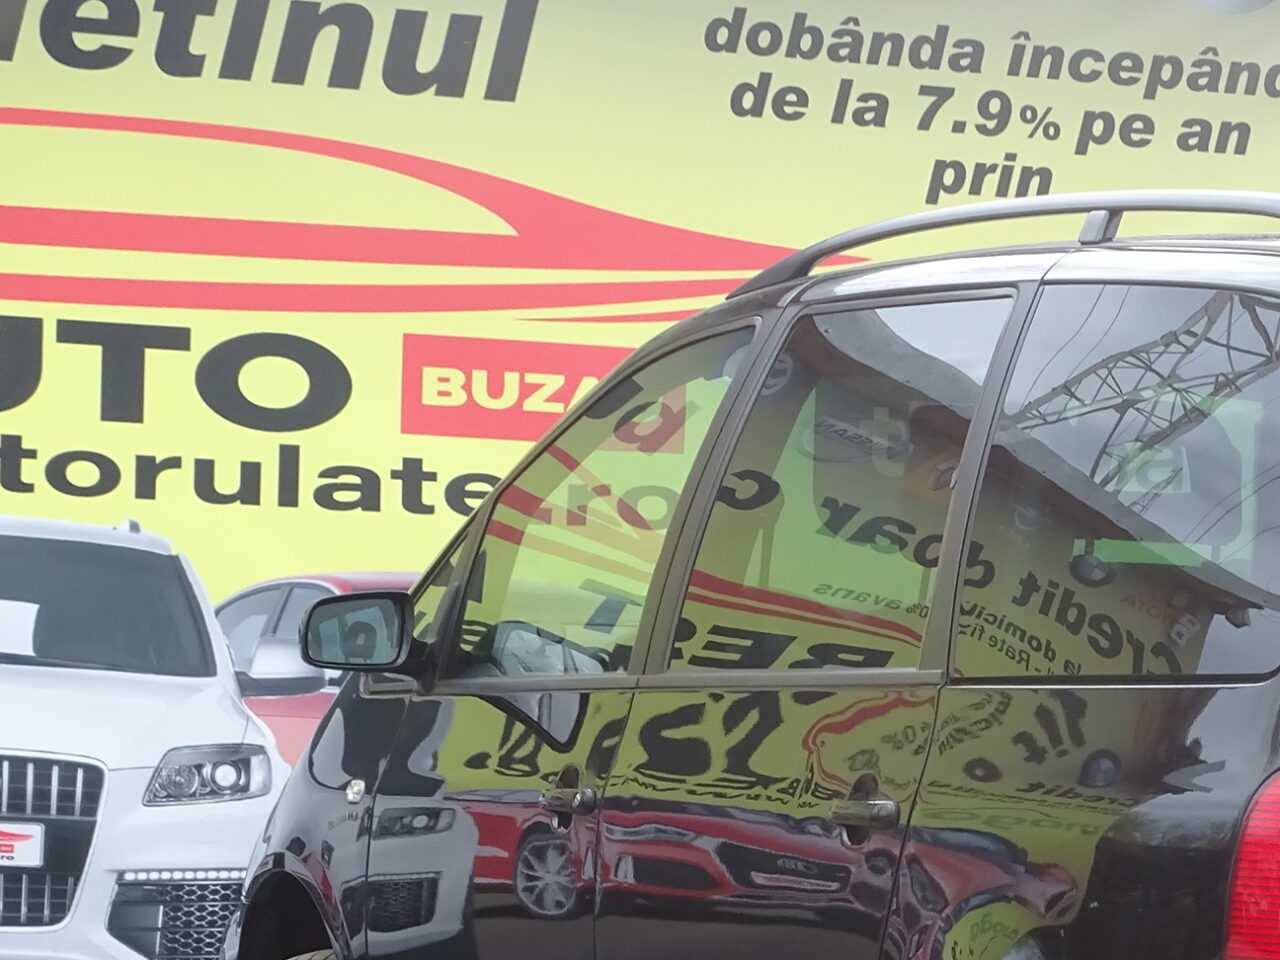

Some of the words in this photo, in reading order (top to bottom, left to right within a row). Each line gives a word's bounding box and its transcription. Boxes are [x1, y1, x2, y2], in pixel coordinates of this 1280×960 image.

[704, 6, 986, 74] dobânda
[730, 71, 810, 122] de
[830, 78, 890, 128] la
[916, 84, 1062, 141] 7.9%
[1074, 109, 1156, 156] pe
[1175, 116, 1252, 156] an
[925, 152, 1053, 205] prin
